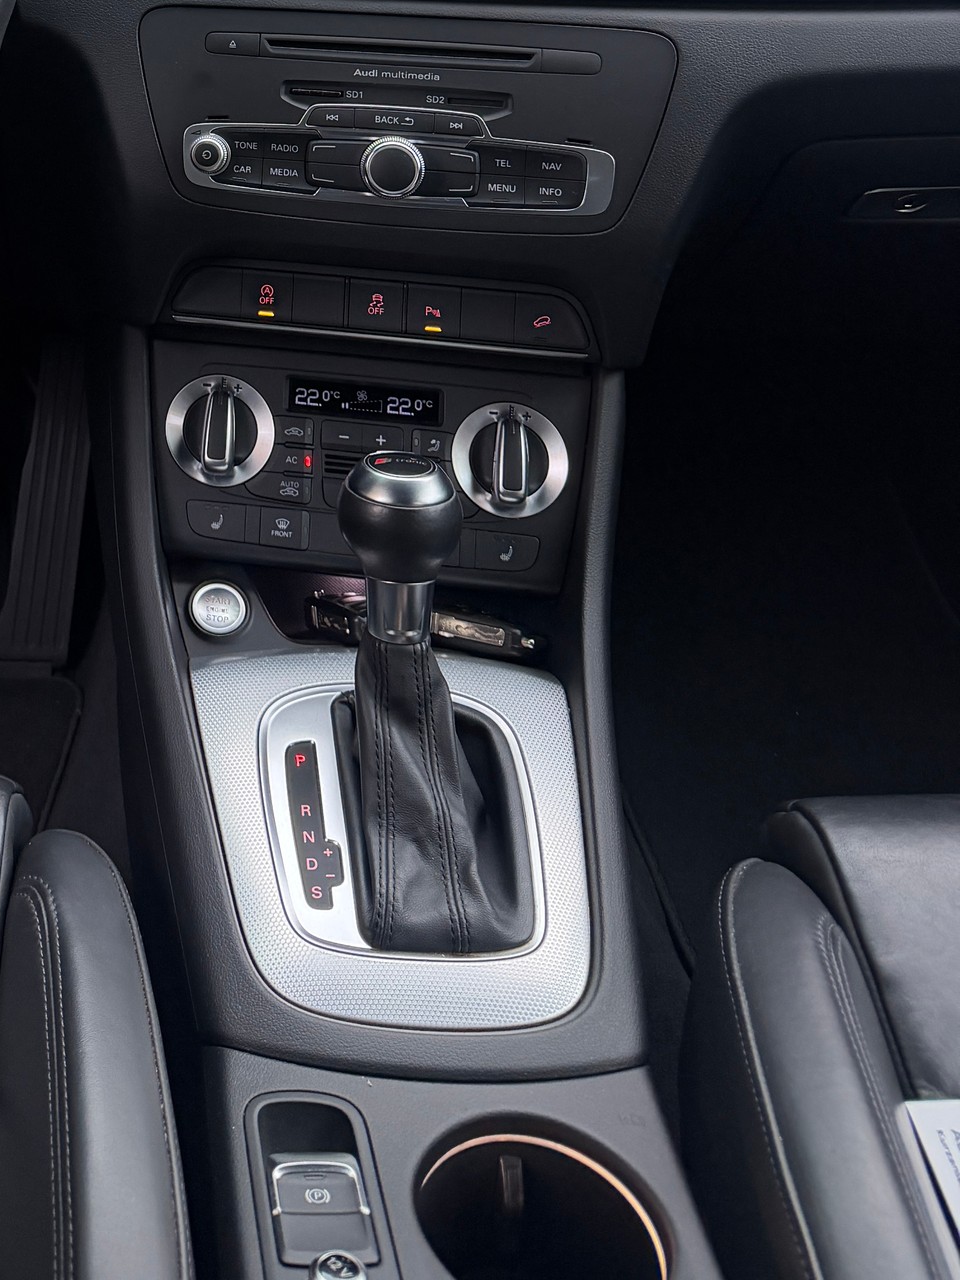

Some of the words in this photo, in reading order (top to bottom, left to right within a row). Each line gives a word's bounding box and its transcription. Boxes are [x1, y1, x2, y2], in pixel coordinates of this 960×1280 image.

[353, 68, 378, 77] Audi
[381, 70, 440, 81] multimedia
[346, 90, 363, 99] SD1
[426, 95, 445, 104] SD2
[375, 115, 399, 125] BACK
[234, 140, 258, 150] TONE
[271, 143, 299, 153] RADIO
[495, 158, 511, 168] TEL
[542, 162, 562, 171] NAV
[233, 165, 251, 174] CAR
[270, 167, 298, 177] MEDIA
[488, 183, 516, 193] MENU
[539, 187, 562, 197] INFO
[259, 296, 274, 305] OFF
[367, 306, 385, 315] OFF
[285, 455, 298, 464] AC
[280, 480, 299, 488] AUTO
[271, 529, 293, 538] FRONT
[205, 596, 231, 606] START
[205, 613, 229, 623] STOP
[295, 754, 306, 766] P
[300, 804, 312, 817] R
[303, 830, 315, 843] N
[306, 857, 318, 871] D
[311, 886, 323, 899] S
